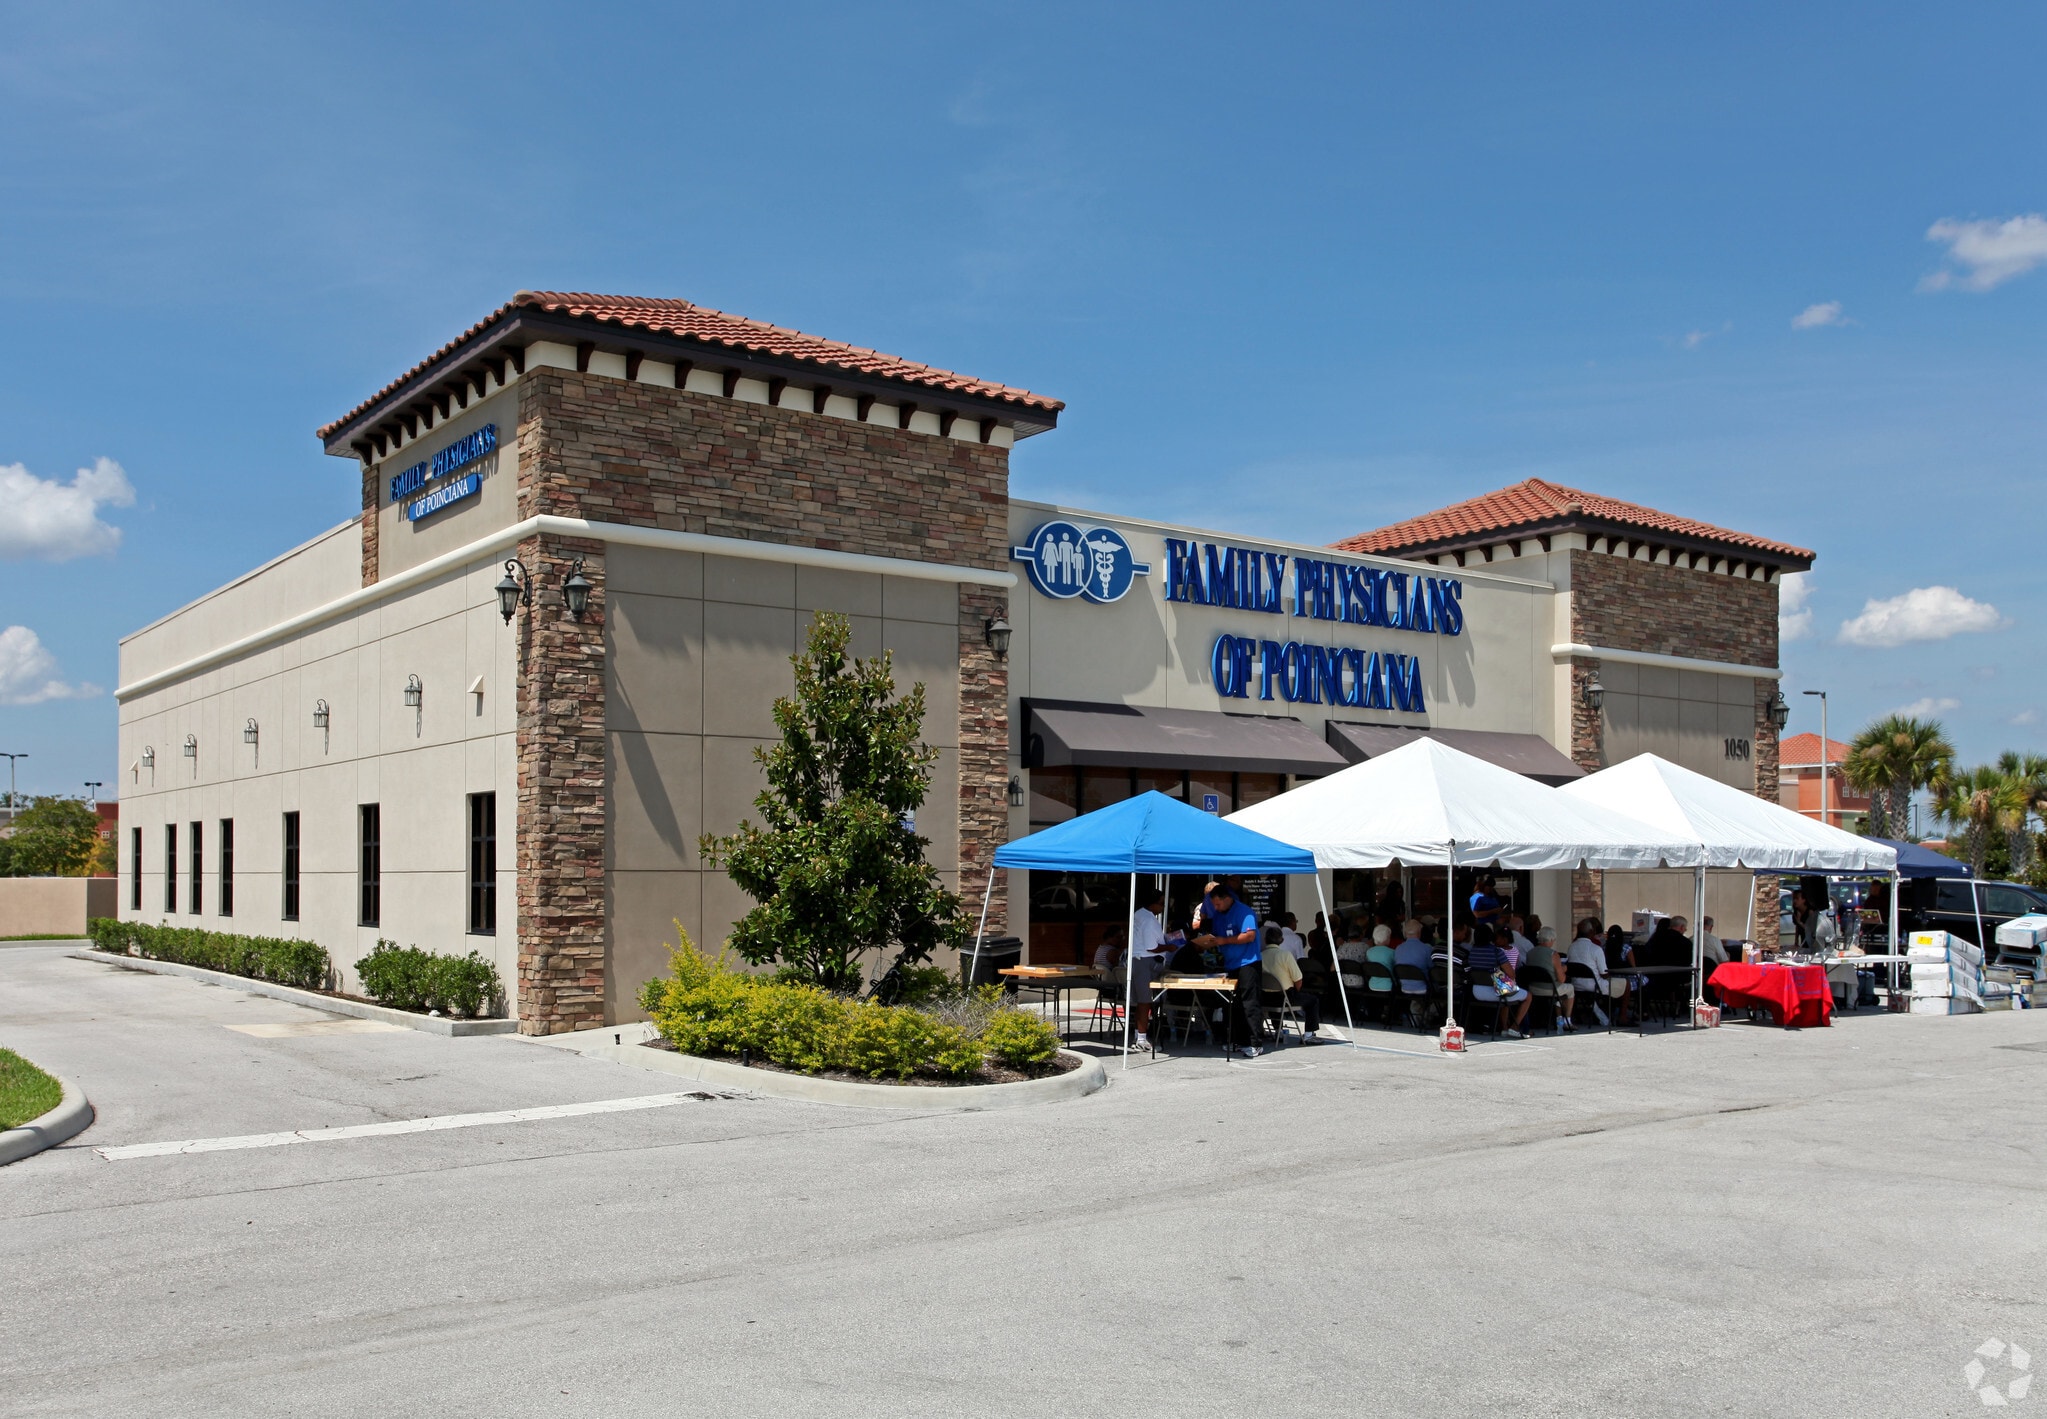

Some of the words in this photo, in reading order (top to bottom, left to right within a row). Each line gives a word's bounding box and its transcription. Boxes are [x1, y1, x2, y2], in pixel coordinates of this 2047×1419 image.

[390, 461, 427, 502] FAMILY
[432, 423, 496, 480] PHYSICIANS
[415, 499, 427, 517] OF
[426, 479, 469, 513] POINCIANA
[1164, 538, 1288, 614] FAMILY
[1292, 556, 1463, 637] PHYSICIANS
[1211, 634, 1257, 699] OF
[1260, 640, 1426, 713] POINCIANA
[1724, 738, 1750, 759] 1050
